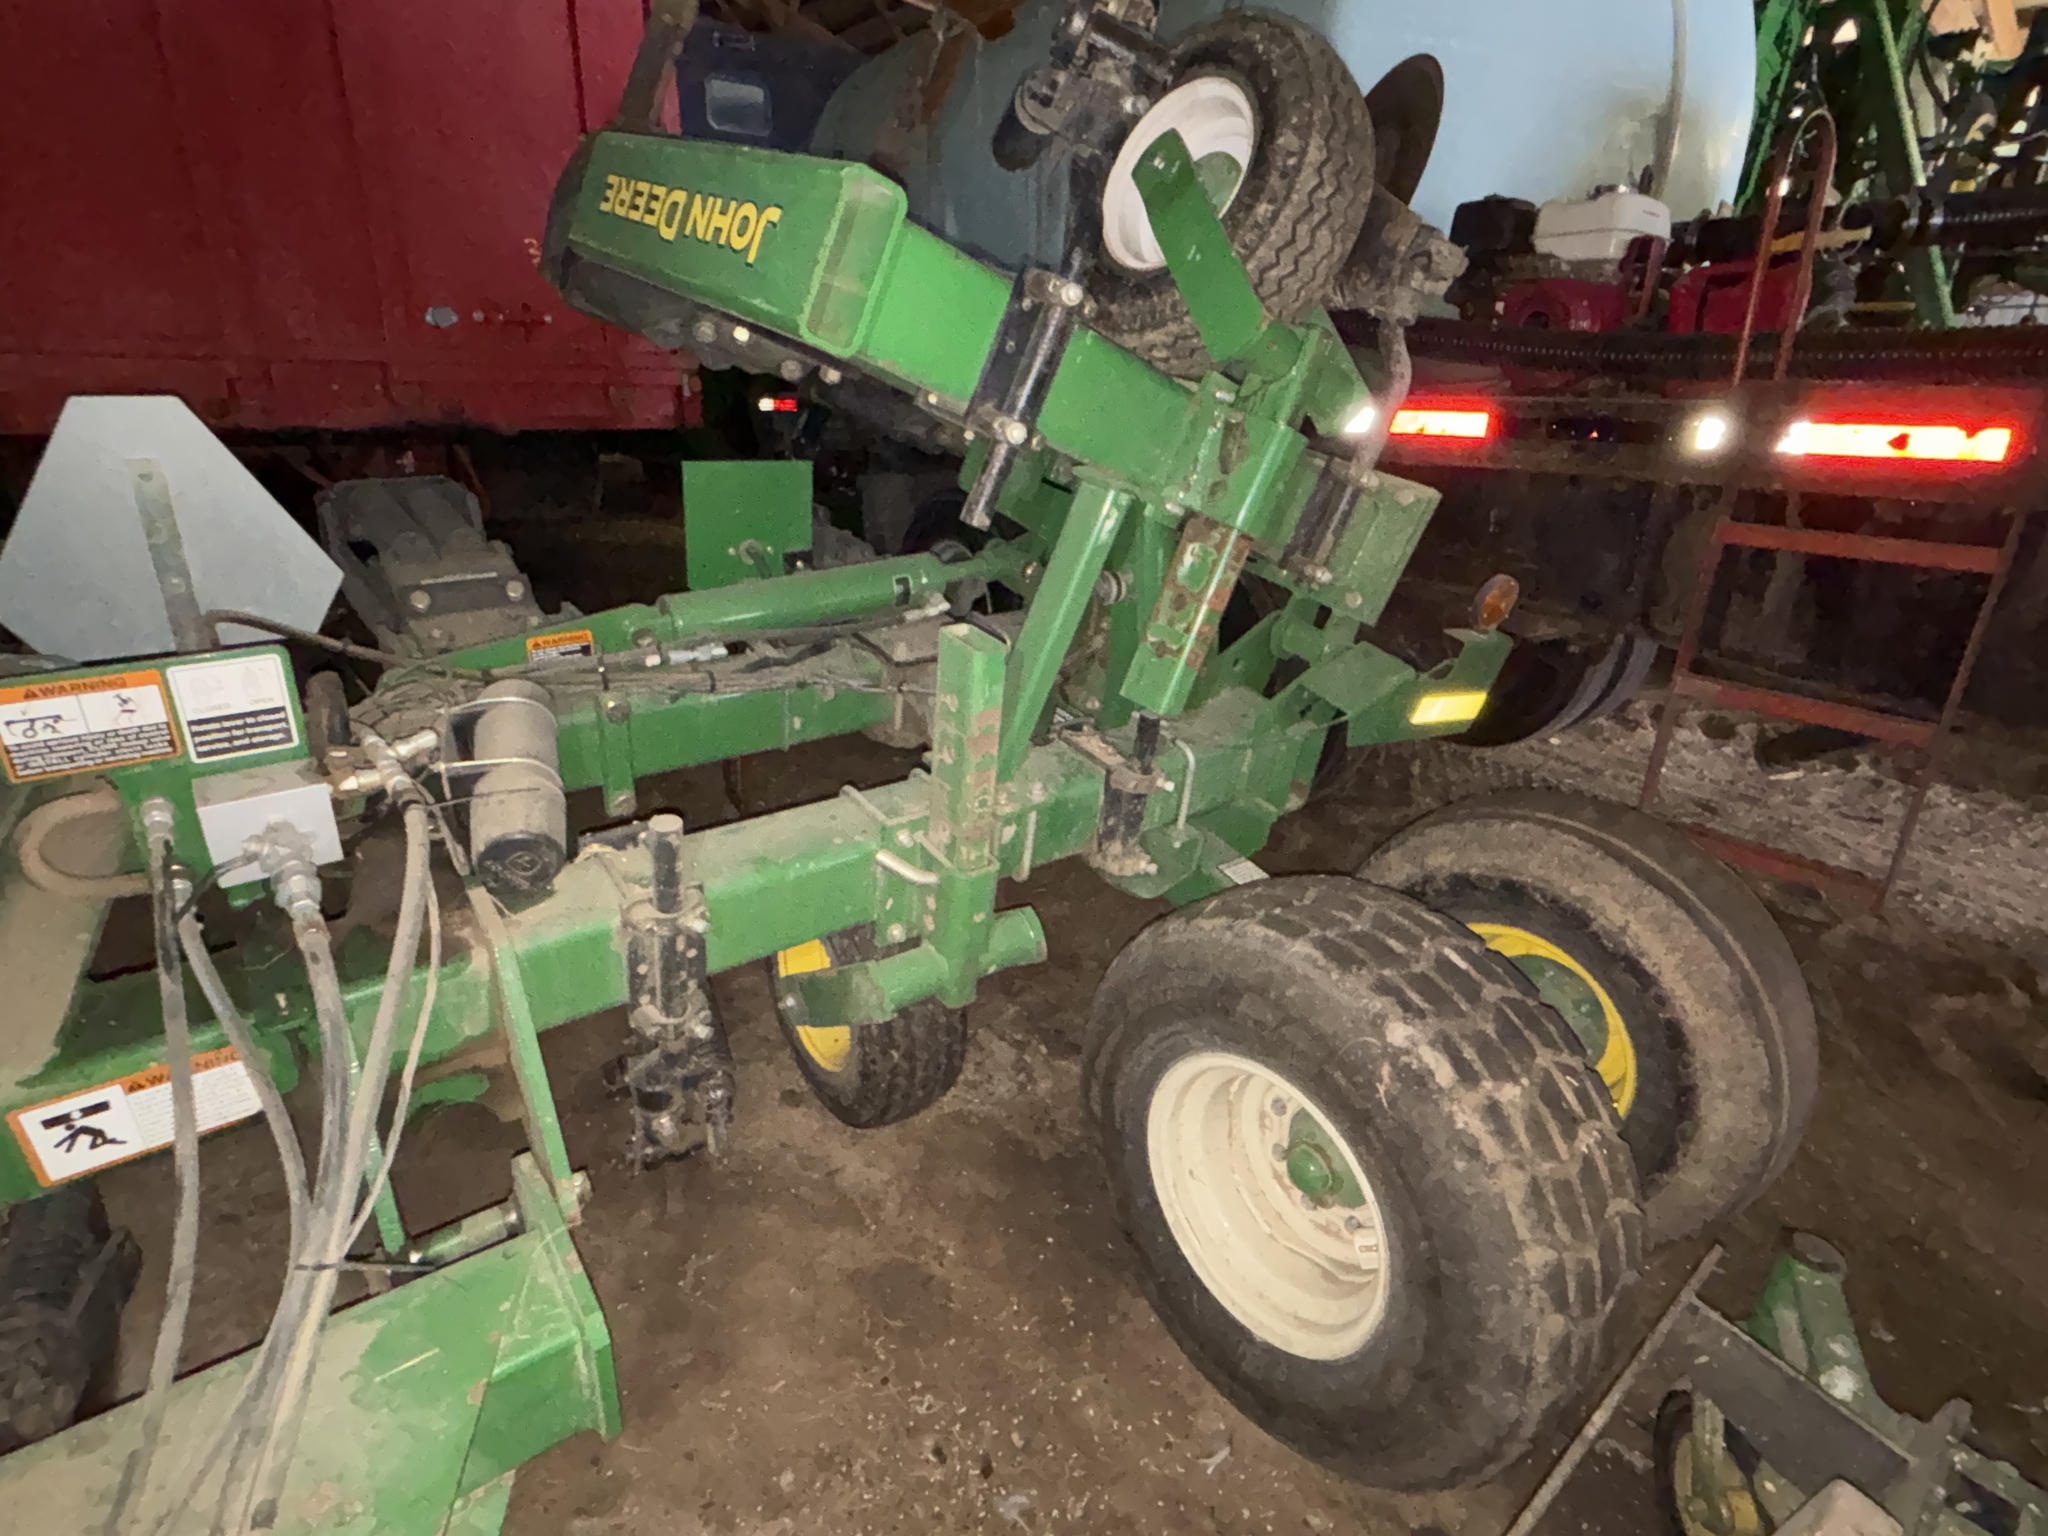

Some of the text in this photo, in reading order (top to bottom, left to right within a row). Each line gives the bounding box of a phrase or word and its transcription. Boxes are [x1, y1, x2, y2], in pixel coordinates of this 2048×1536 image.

[599, 173, 782, 264] JOHN DEERE
[37, 676, 127, 697] WARNING
